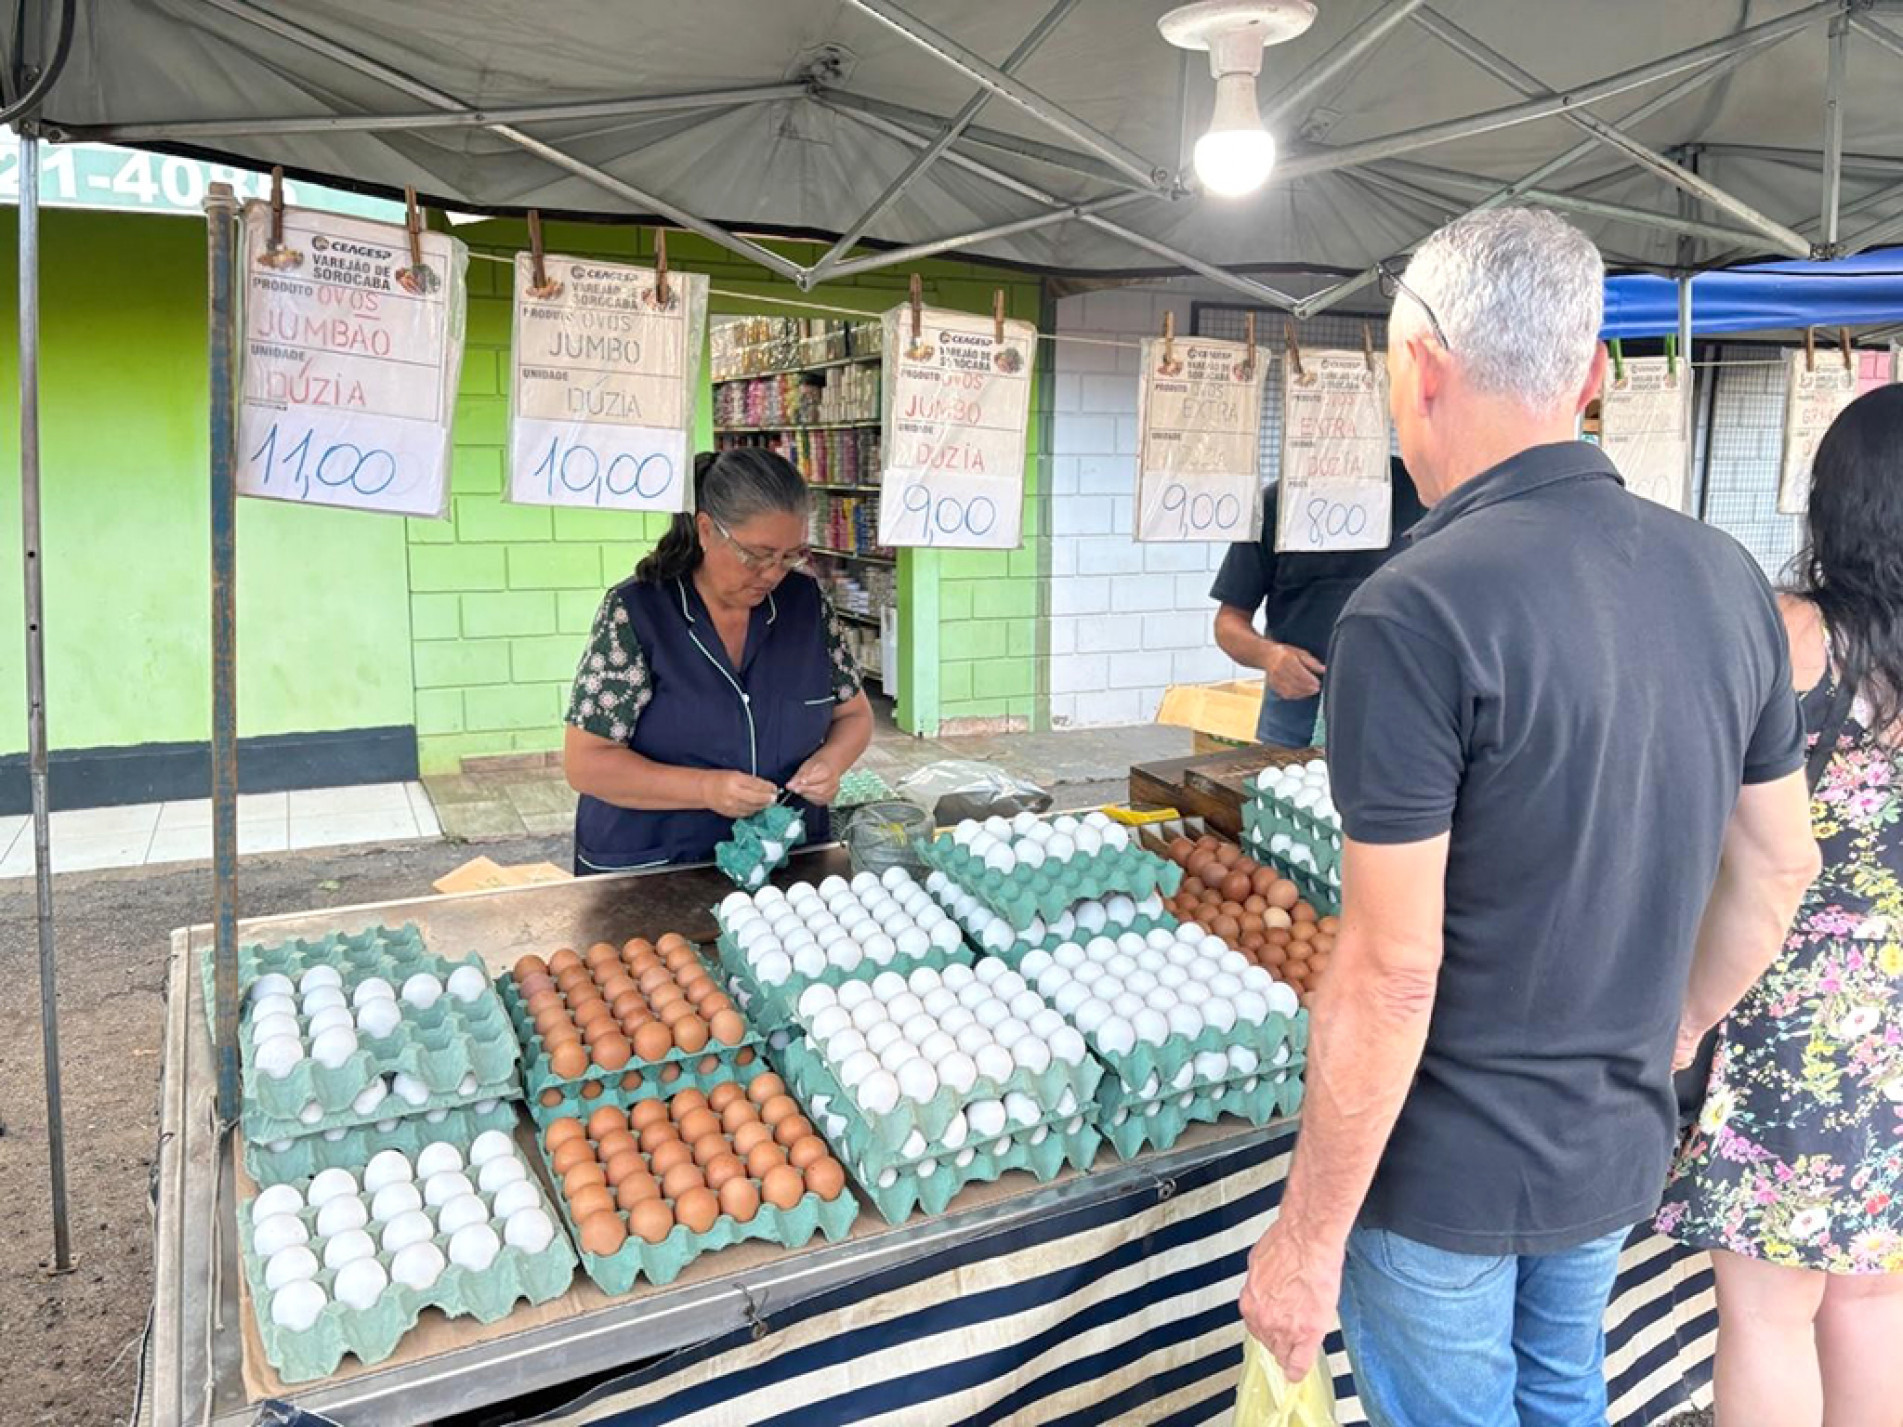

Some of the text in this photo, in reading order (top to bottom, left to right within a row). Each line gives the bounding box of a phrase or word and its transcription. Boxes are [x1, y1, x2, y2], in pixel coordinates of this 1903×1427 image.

[331, 241, 393, 260] CEAGESP
[312, 253, 391, 278] VAREJÃO DE
[313, 267, 391, 291] SOROCABA
[252, 277, 313, 297] PRODUTO
[317, 284, 380, 311] OVOS
[250, 343, 306, 362] UNIDADE
[548, 331, 641, 365] JUMBO
[522, 368, 569, 382] UNIDADE
[250, 423, 397, 499] 11,00
[534, 436, 674, 505] 10,00
[903, 483, 996, 545] 9,00
[1162, 483, 1241, 539] 9,00
[1306, 497, 1367, 547] 8,00
